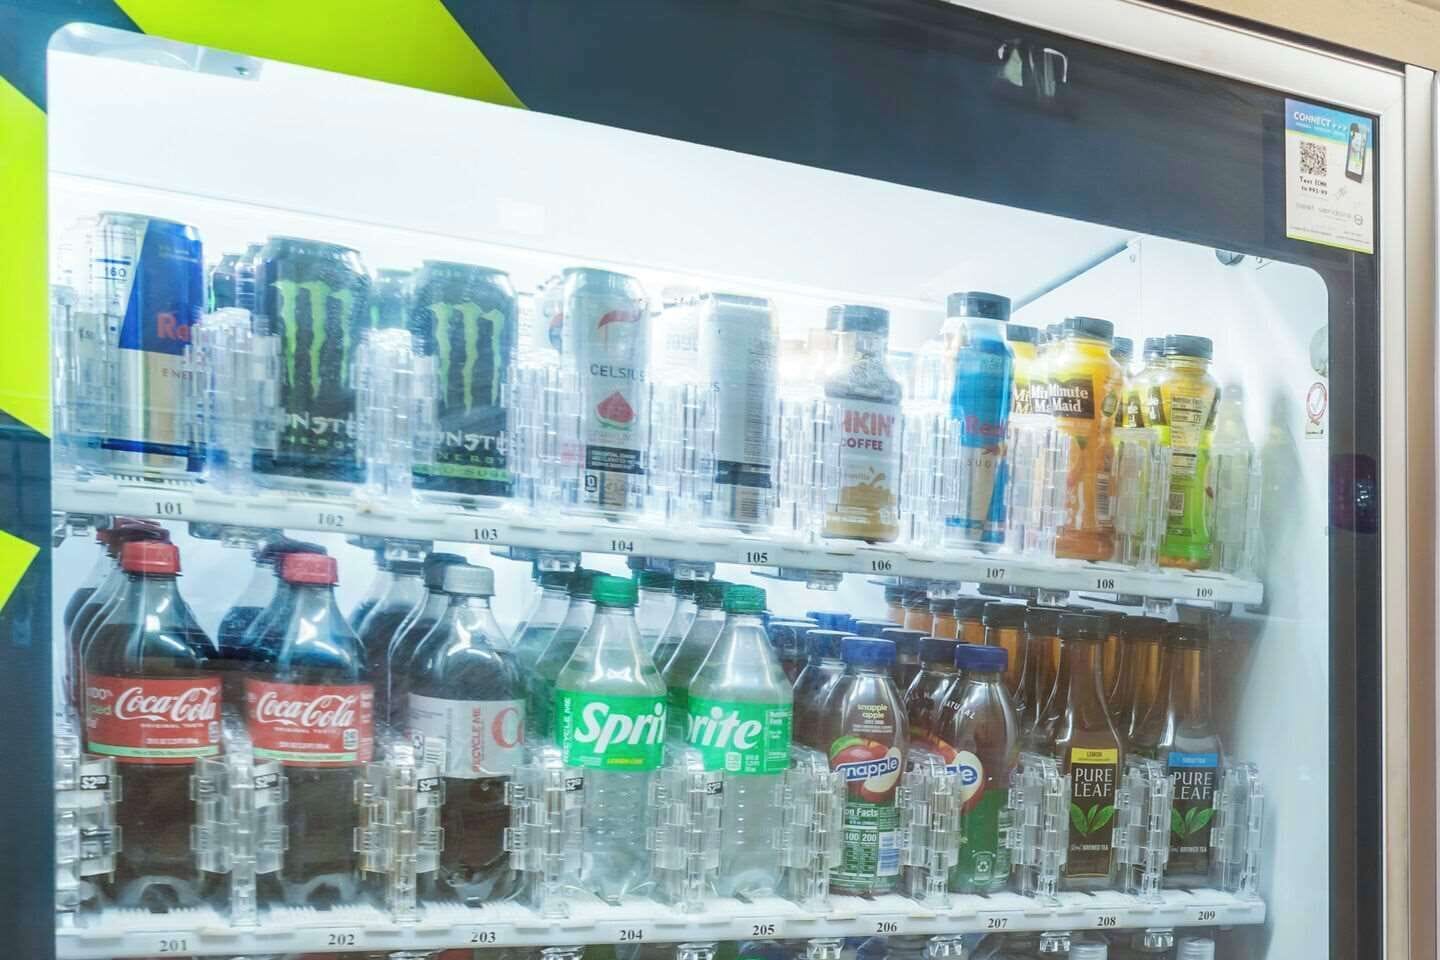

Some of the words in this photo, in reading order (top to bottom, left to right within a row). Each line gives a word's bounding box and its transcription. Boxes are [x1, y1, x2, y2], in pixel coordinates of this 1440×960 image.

[1294, 111, 1331, 127] CONNECT
[156, 311, 192, 342] Re
[1048, 383, 1089, 400] Minute
[1051, 399, 1082, 413] Maid
[155, 501, 184, 515] 101
[317, 513, 345, 527] 102
[473, 528, 499, 541] 103
[611, 540, 634, 552] 104
[746, 551, 769, 564] 105
[871, 560, 892, 572] 106
[986, 567, 1006, 579] 107
[1096, 579, 1115, 589] 108
[1196, 587, 1213, 598] 109
[256, 690, 356, 728] Coca-Cola
[472, 706, 481, 724] ME
[574, 701, 667, 754] Spri
[687, 706, 762, 750] rite
[471, 725, 481, 773] RECYCLE
[1075, 767, 1113, 783] PURE
[1172, 771, 1213, 786] PURE
[1074, 782, 1113, 798] LEAF
[1173, 786, 1213, 800] LEAF
[862, 833, 877, 842] 200
[1097, 916, 1117, 928] 208
[1198, 910, 1216, 922] 209
[752, 924, 776, 936] 205
[876, 921, 898, 934] 206
[987, 918, 1008, 930] 207
[328, 933, 355, 946] 202
[470, 931, 497, 944] 203
[619, 928, 643, 941] 204
[160, 939, 188, 952] 201
